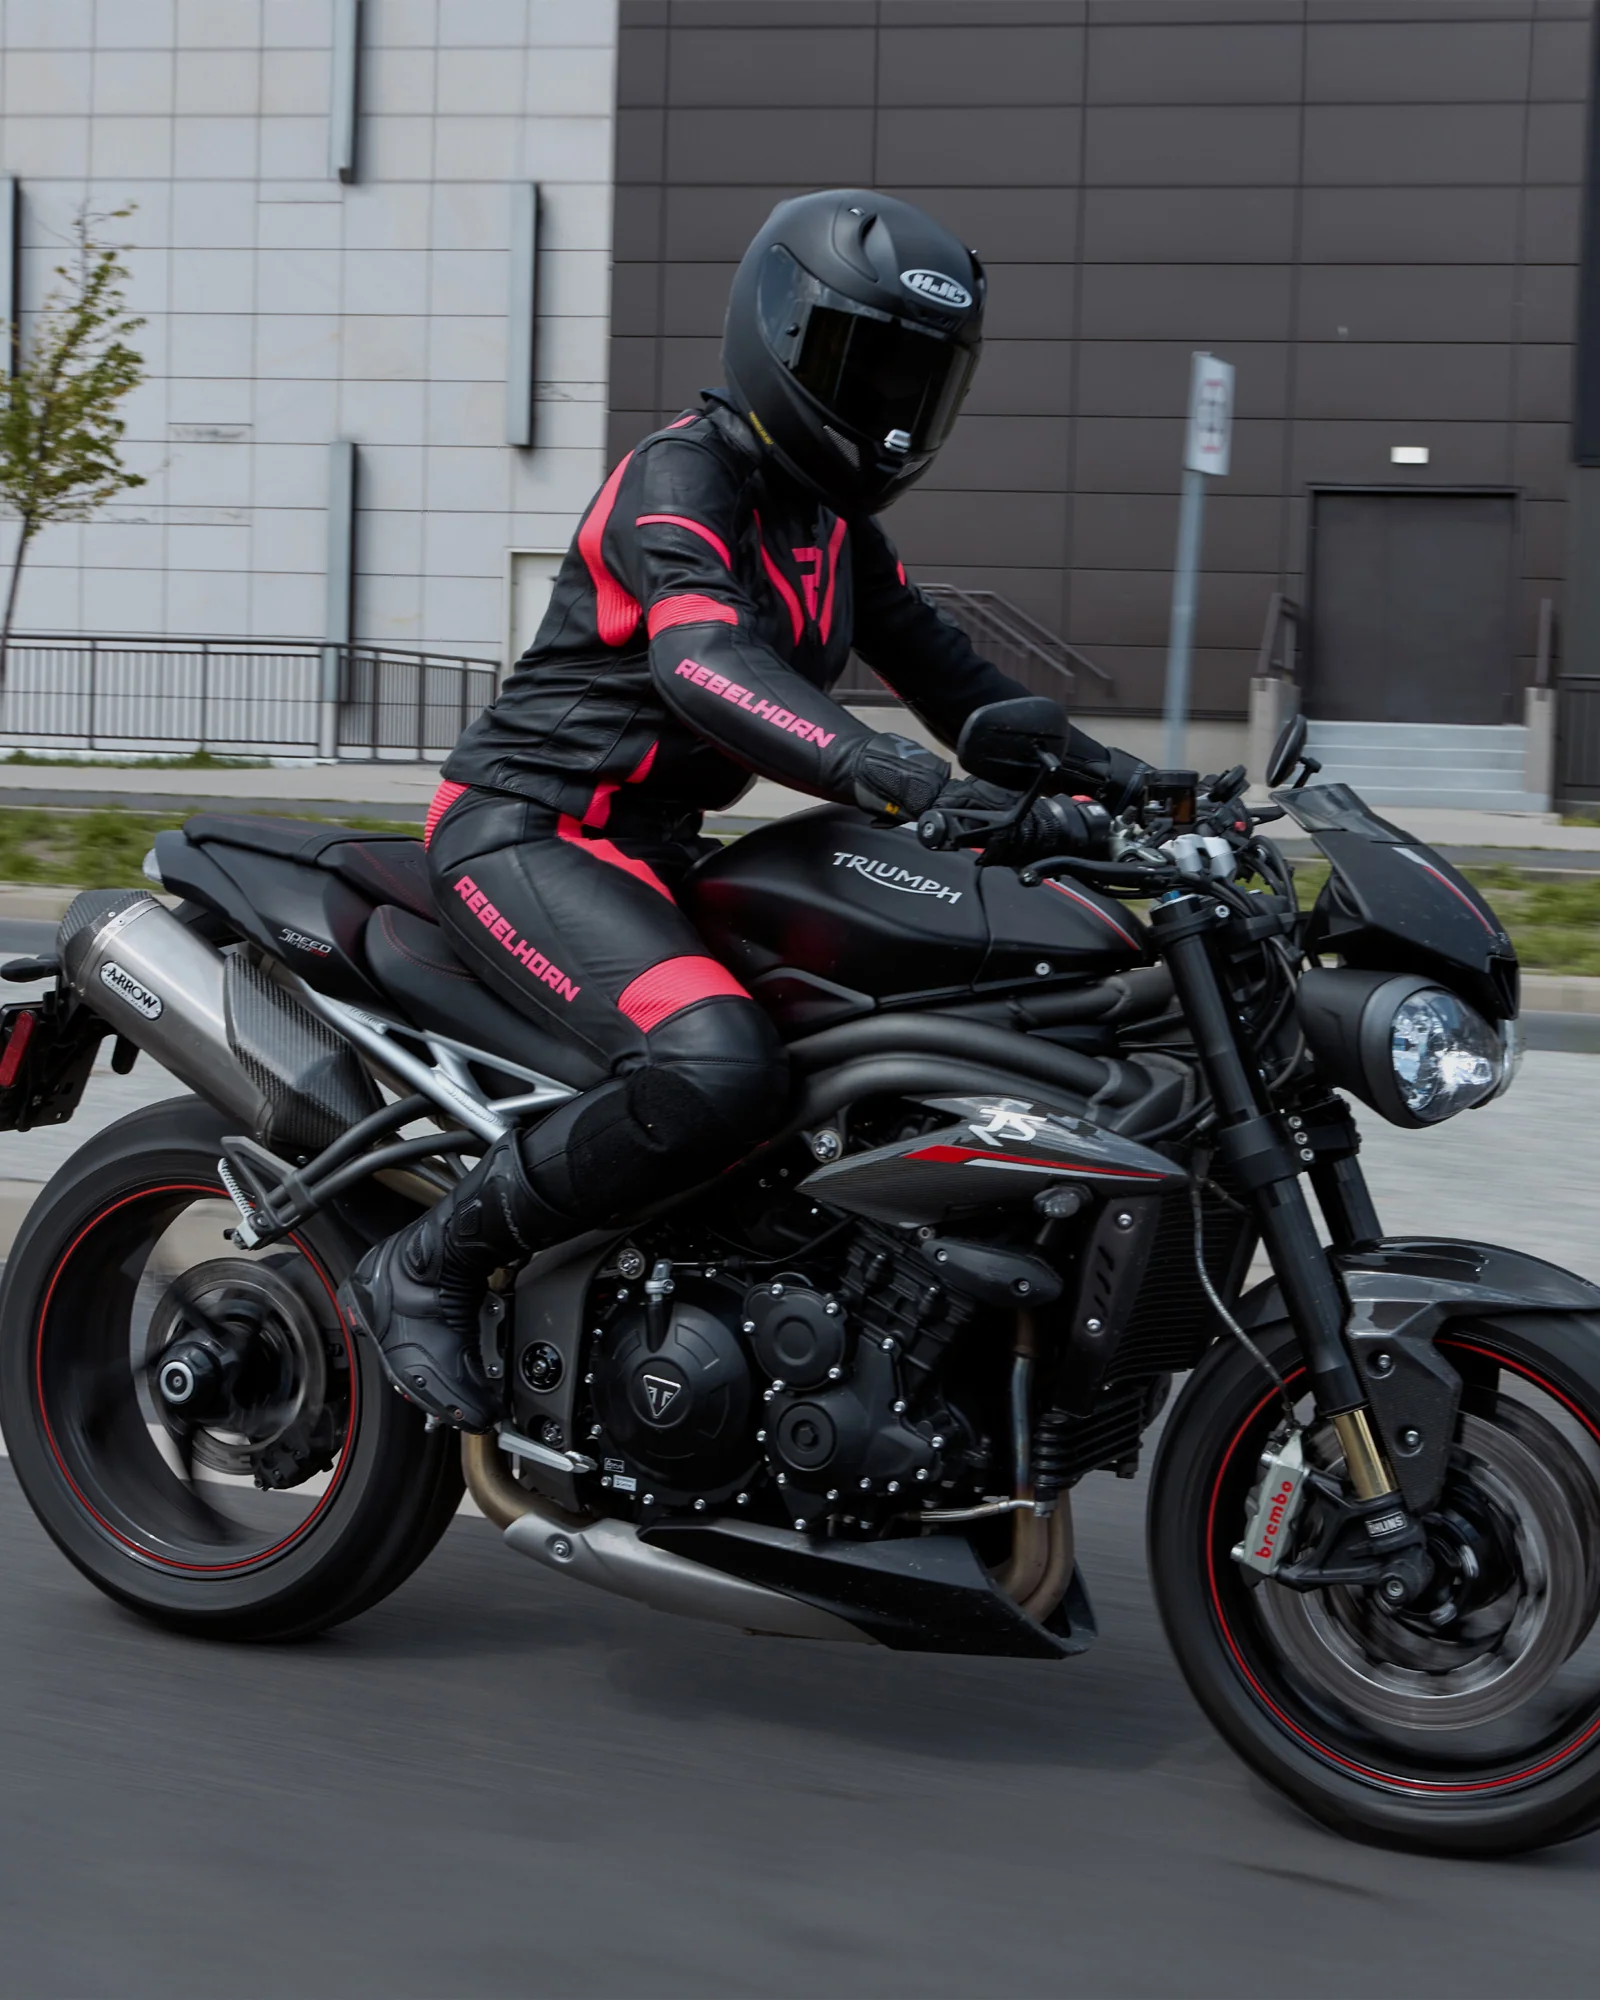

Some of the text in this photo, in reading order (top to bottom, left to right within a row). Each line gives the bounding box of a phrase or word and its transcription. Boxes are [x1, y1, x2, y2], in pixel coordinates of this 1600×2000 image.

[910, 273, 967, 303] HJC
[674, 658, 837, 748] REBELHORN
[832, 852, 963, 904] TRIUMPH
[453, 875, 581, 1002] REBELHORN
[106, 967, 158, 1009] ARROW
[1254, 1480, 1293, 1559] brembo
